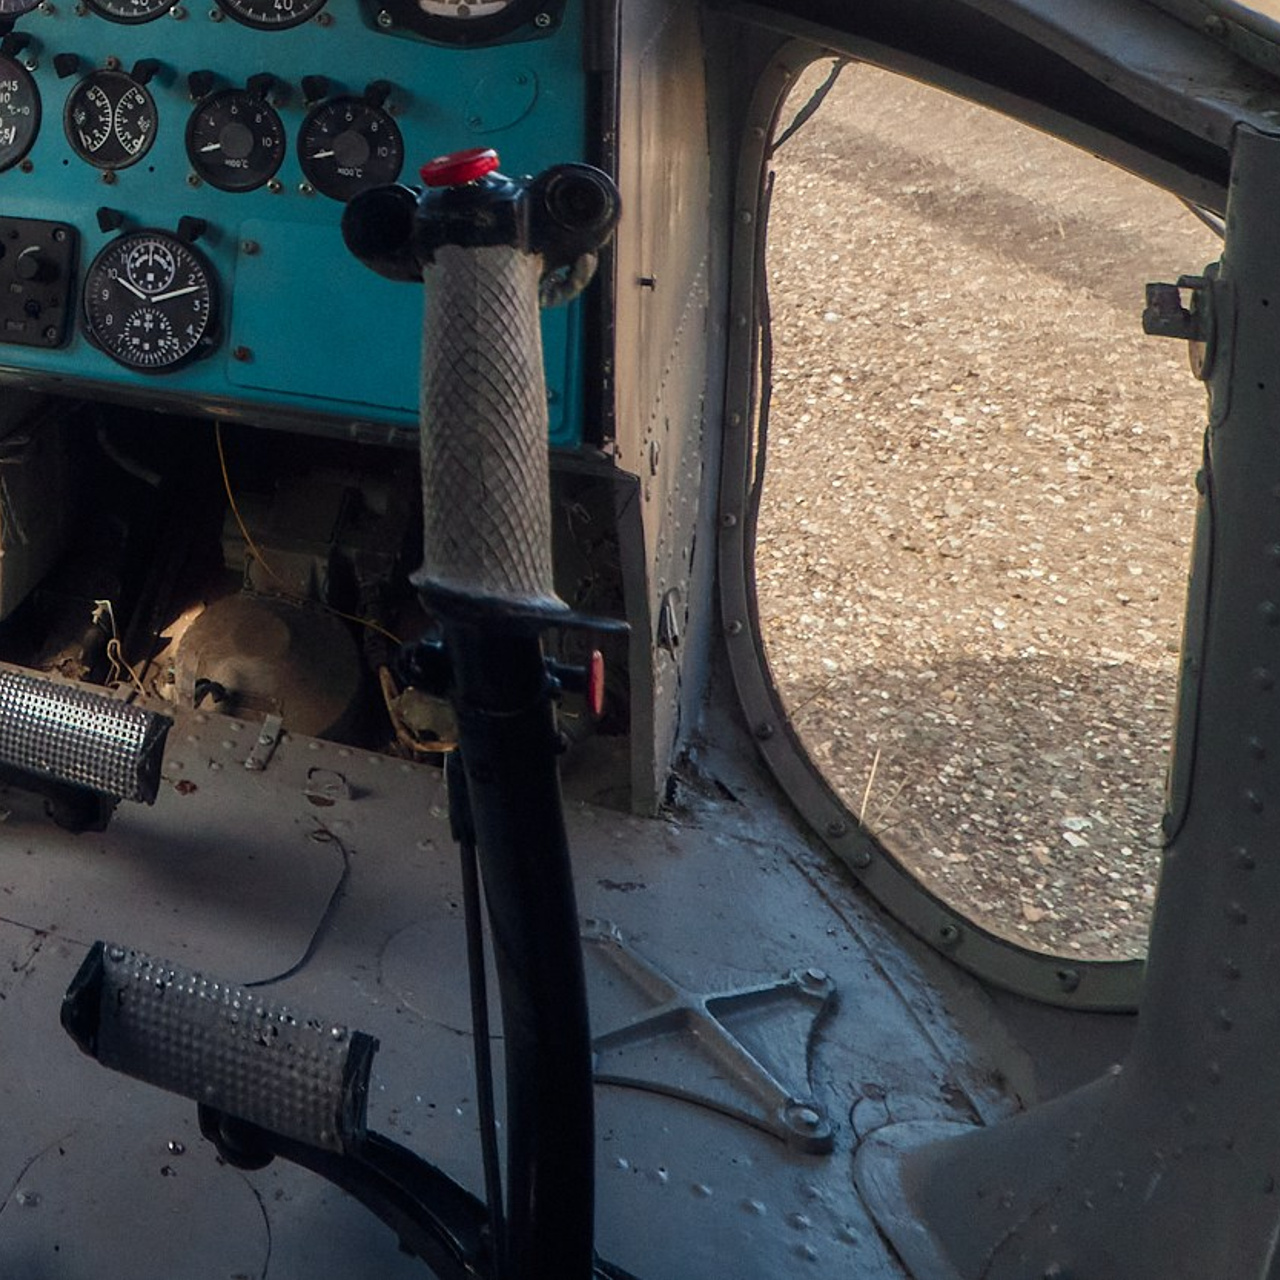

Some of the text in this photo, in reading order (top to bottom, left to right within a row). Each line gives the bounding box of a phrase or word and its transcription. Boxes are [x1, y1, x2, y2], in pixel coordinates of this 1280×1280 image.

[7, 80, 18, 91] 15
[0, 92, 10, 103] 10
[231, 106, 238, 115] 6
[255, 114, 262, 123] 8
[345, 112, 353, 121] 6
[371, 122, 378, 131] 8
[262, 138, 272, 147] 10
[377, 147, 387, 156] 10
[107, 268, 118, 279] 10
[188, 274, 195, 285] 2
[102, 289, 109, 300] 9
[193, 300, 200, 311] 3
[106, 314, 113, 325] 8
[186, 324, 193, 336] 4
[117, 334, 125, 345] 7
[172, 337, 180, 350] 5
